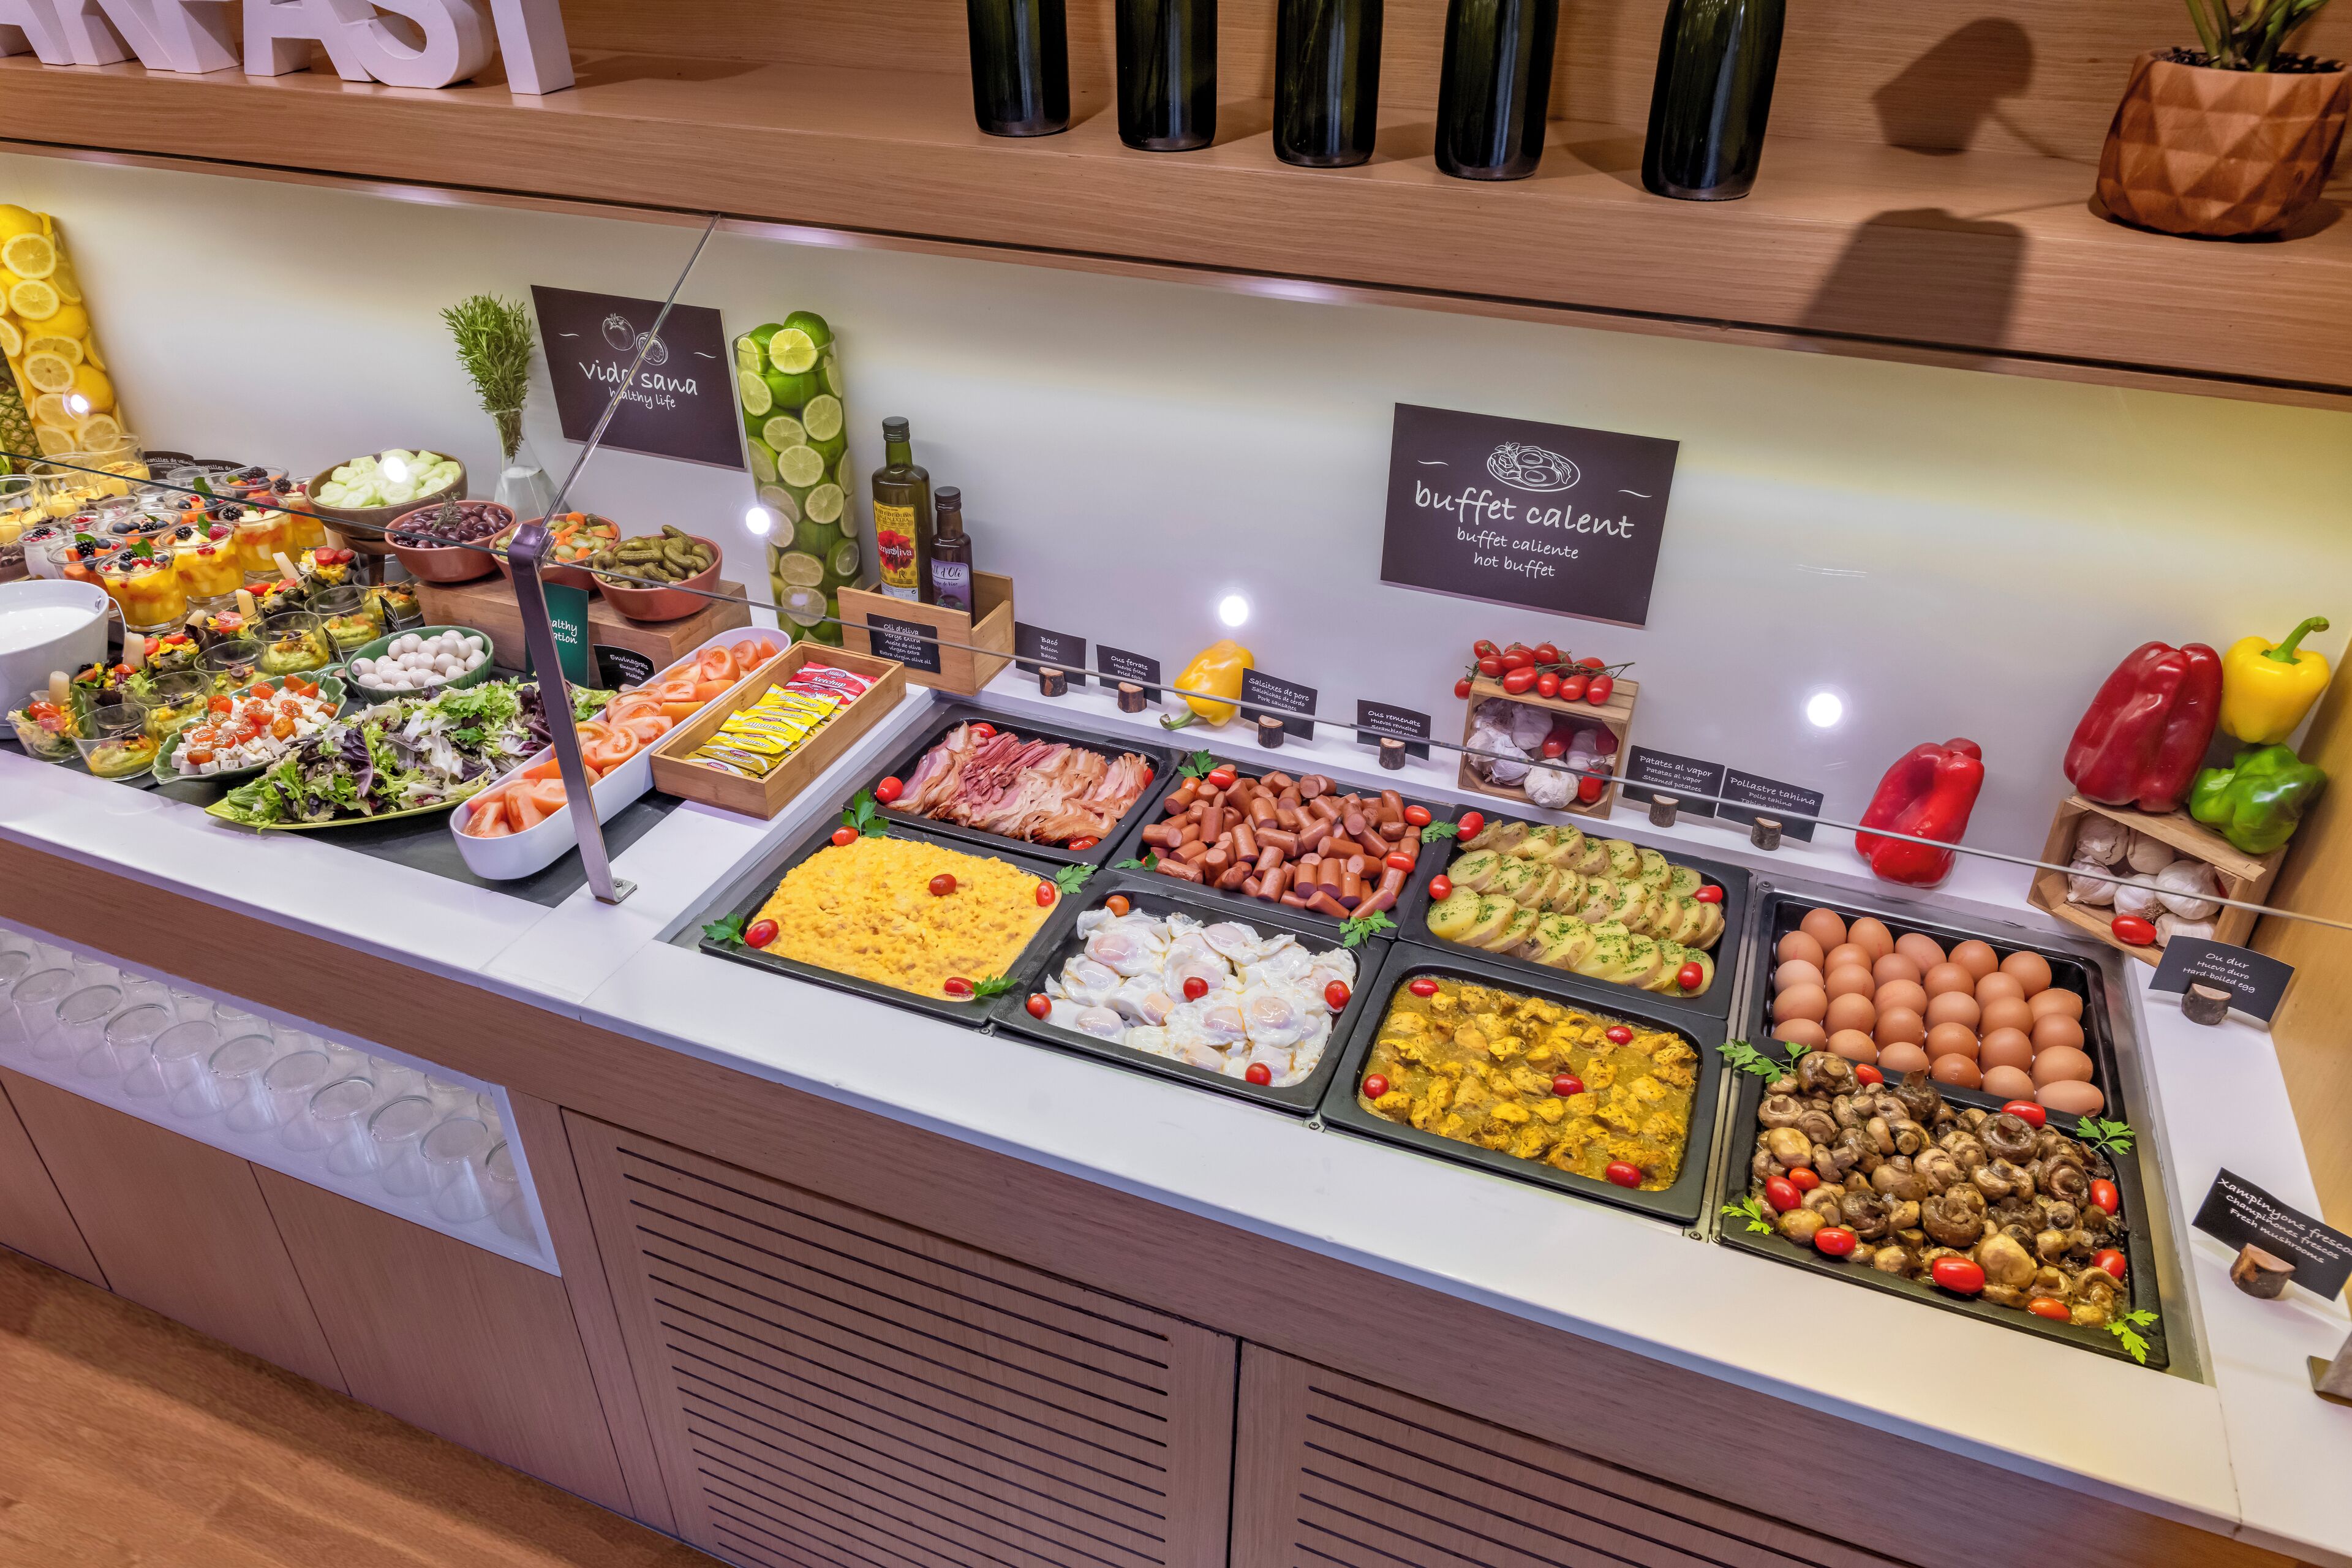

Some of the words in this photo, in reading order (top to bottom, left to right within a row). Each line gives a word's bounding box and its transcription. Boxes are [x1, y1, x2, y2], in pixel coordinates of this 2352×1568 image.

[641, 373, 698, 396] sana
[609, 387, 653, 409] halthy
[655, 394, 676, 410] life
[1415, 480, 1517, 525] buffet
[1526, 505, 1634, 538] calent
[1457, 527, 1508, 549] buffet
[1512, 539, 1578, 559] caliente
[1474, 552, 1499, 568] hot
[1504, 556, 1556, 579] buffet
[896, 625, 919, 636] d'oliva
[1040, 644, 1058, 654] Beicon
[1041, 636, 1058, 646] Bacó
[609, 654, 649, 670] Envinagrats
[1126, 658, 1148, 670] ferrats
[1133, 668, 1146, 676] fritos
[812, 676, 846, 688] Ketchup
[1248, 678, 1282, 693] Salsitxes
[1294, 692, 1310, 701] porc
[1251, 687, 1281, 700] Salchichas
[1257, 695, 1270, 703] Pork
[1271, 700, 1297, 711] sausages
[1371, 718, 1392, 726] Huevos
[1393, 723, 1418, 733] revueltos
[1386, 714, 1421, 727] remenats
[1640, 755, 1672, 769] Patates
[1687, 767, 1713, 777] vapor
[1646, 766, 1672, 777] Patatas
[1642, 775, 1673, 786] Steamed
[1674, 782, 1702, 793] potatoes
[1730, 777, 1776, 795] Pollastre
[1779, 790, 1815, 805] tahina
[1749, 792, 1766, 801] Pollo
[1768, 797, 1792, 807] tahina
[2206, 952, 2223, 962] Ou
[2226, 957, 2250, 969] dur
[2196, 960, 2225, 973] Huevo
[2227, 968, 2250, 980] duro
[2182, 967, 2237, 986] Hard-boiled
[2237, 982, 2256, 993] egg
[2217, 1178, 2306, 1231] Xampinyons
[2226, 1194, 2299, 1238] Champiñones
[2301, 1236, 2340, 1260] frescos
[2230, 1208, 2258, 1228] Fresh
[2260, 1226, 2324, 1264] mushrooms
